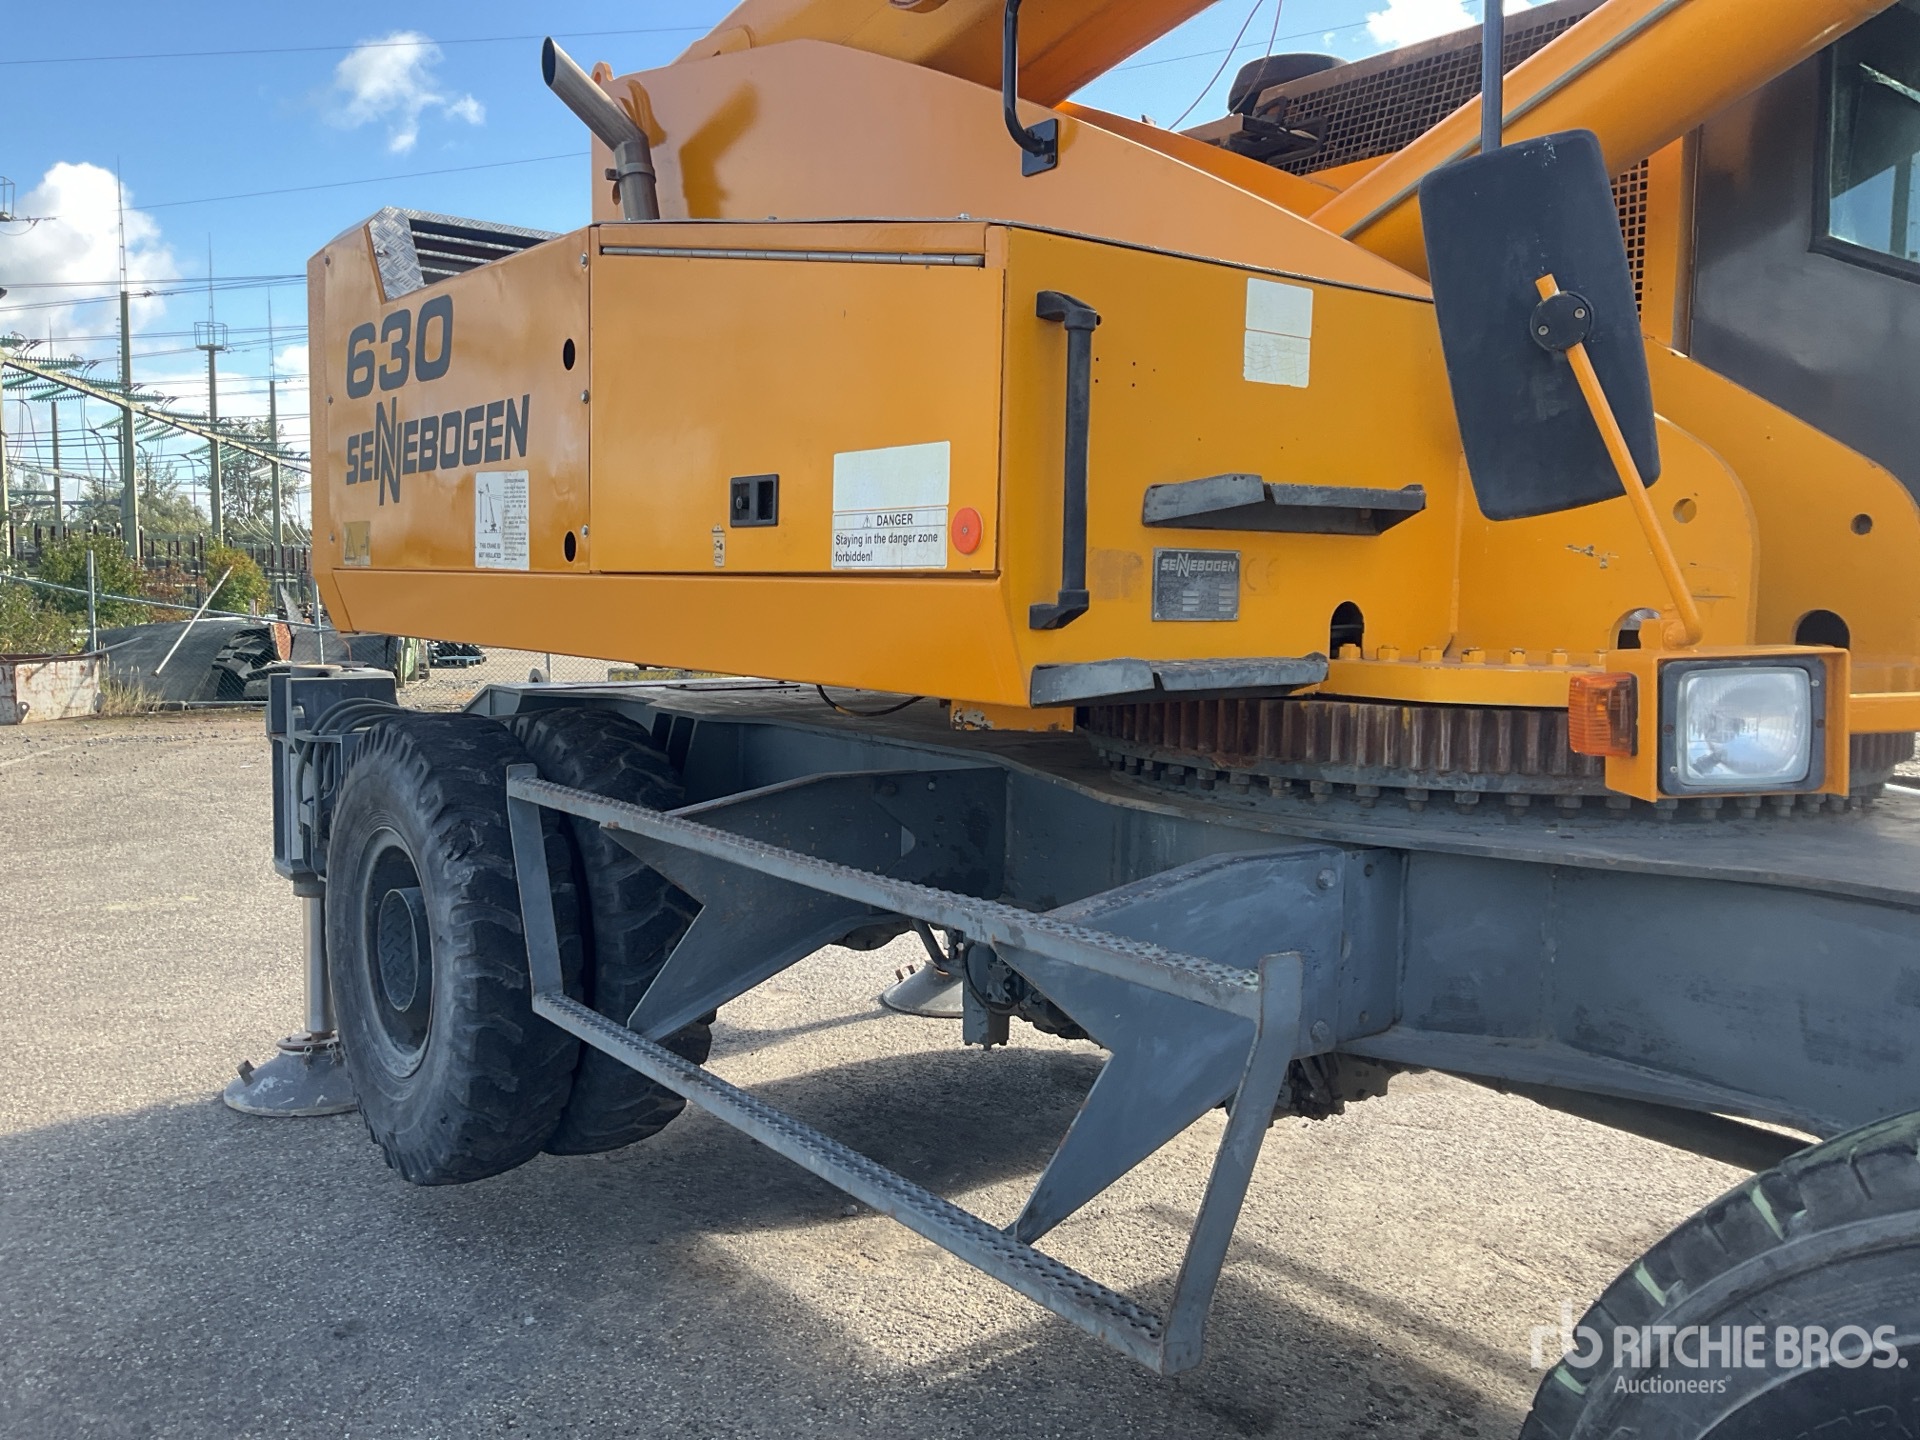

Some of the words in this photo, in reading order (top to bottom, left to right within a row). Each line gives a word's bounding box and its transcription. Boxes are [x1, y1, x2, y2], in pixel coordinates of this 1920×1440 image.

[346, 294, 453, 399] 630
[346, 394, 530, 506] SENNEBOGEN
[876, 513, 913, 526] DANGER
[835, 534, 863, 548] Staying
[865, 533, 872, 544] in
[874, 533, 886, 544] the
[888, 532, 916, 547] danger
[918, 533, 938, 543] zone
[835, 551, 873, 562] forbidden!
[1161, 553, 1236, 577] SENNEBOGEN
